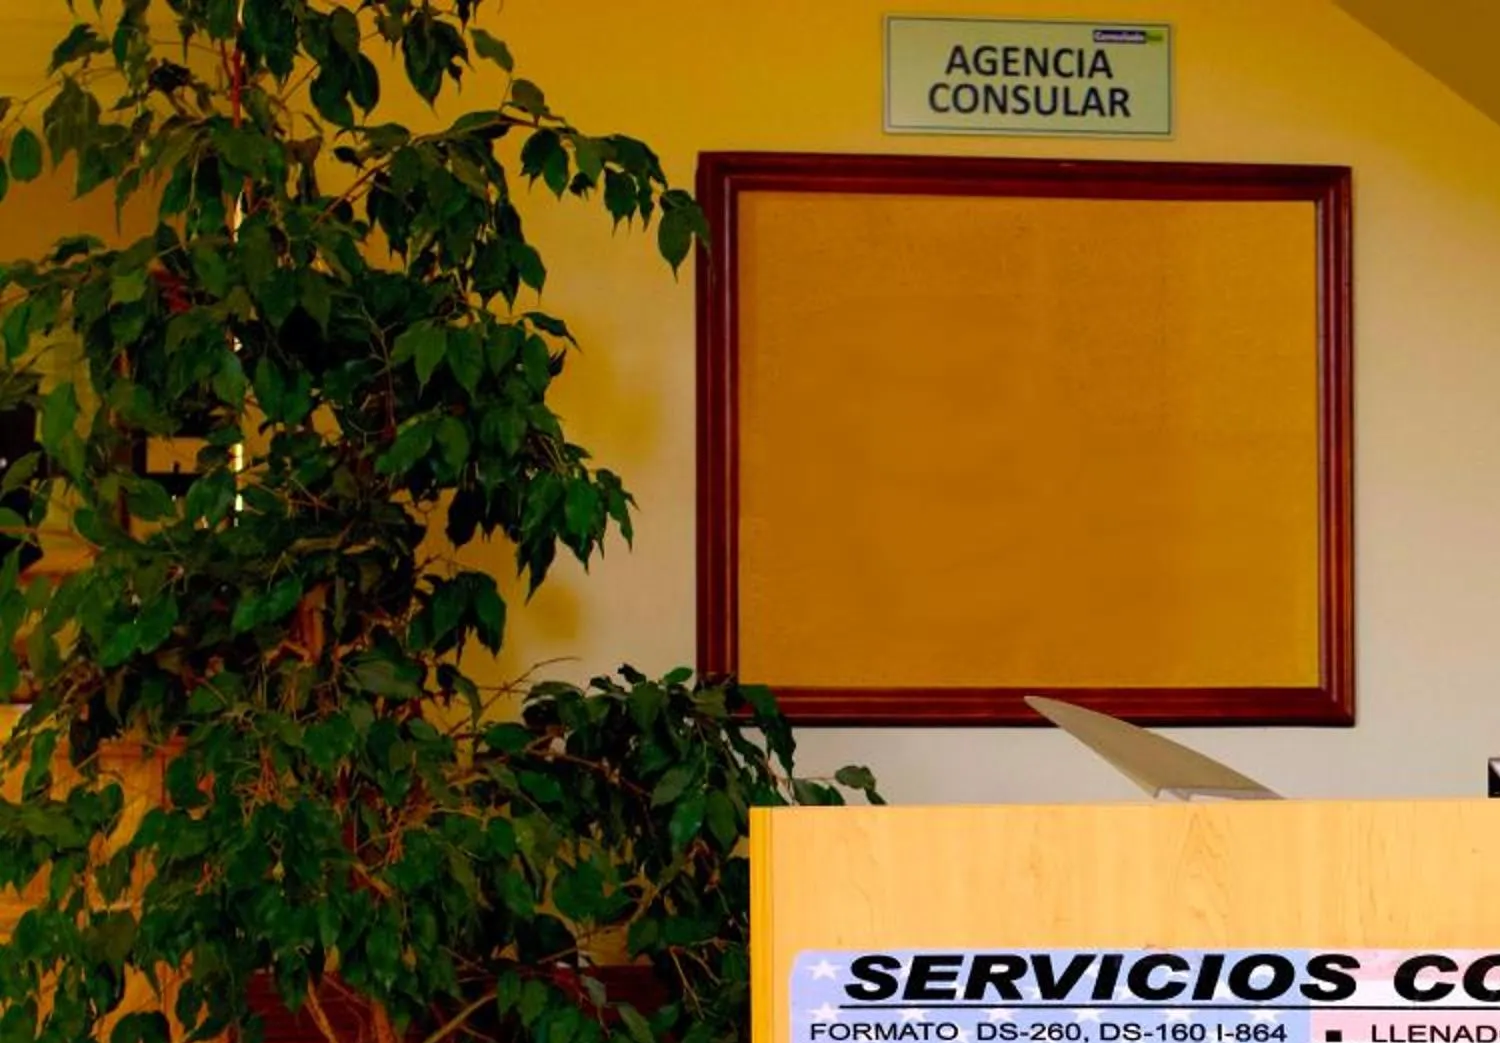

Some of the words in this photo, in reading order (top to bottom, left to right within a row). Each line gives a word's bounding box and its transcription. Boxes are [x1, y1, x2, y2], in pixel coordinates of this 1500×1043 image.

[945, 45, 1113, 79] AGENCIA
[928, 82, 1131, 117] CONSULAR
[843, 953, 1361, 1002] SERVICIOS
[810, 1021, 959, 1041] FORMATO
[976, 1021, 1089, 1043] DS-260,
[1099, 1022, 1207, 1043] DS-160
[1216, 1023, 1288, 1043] I-864
